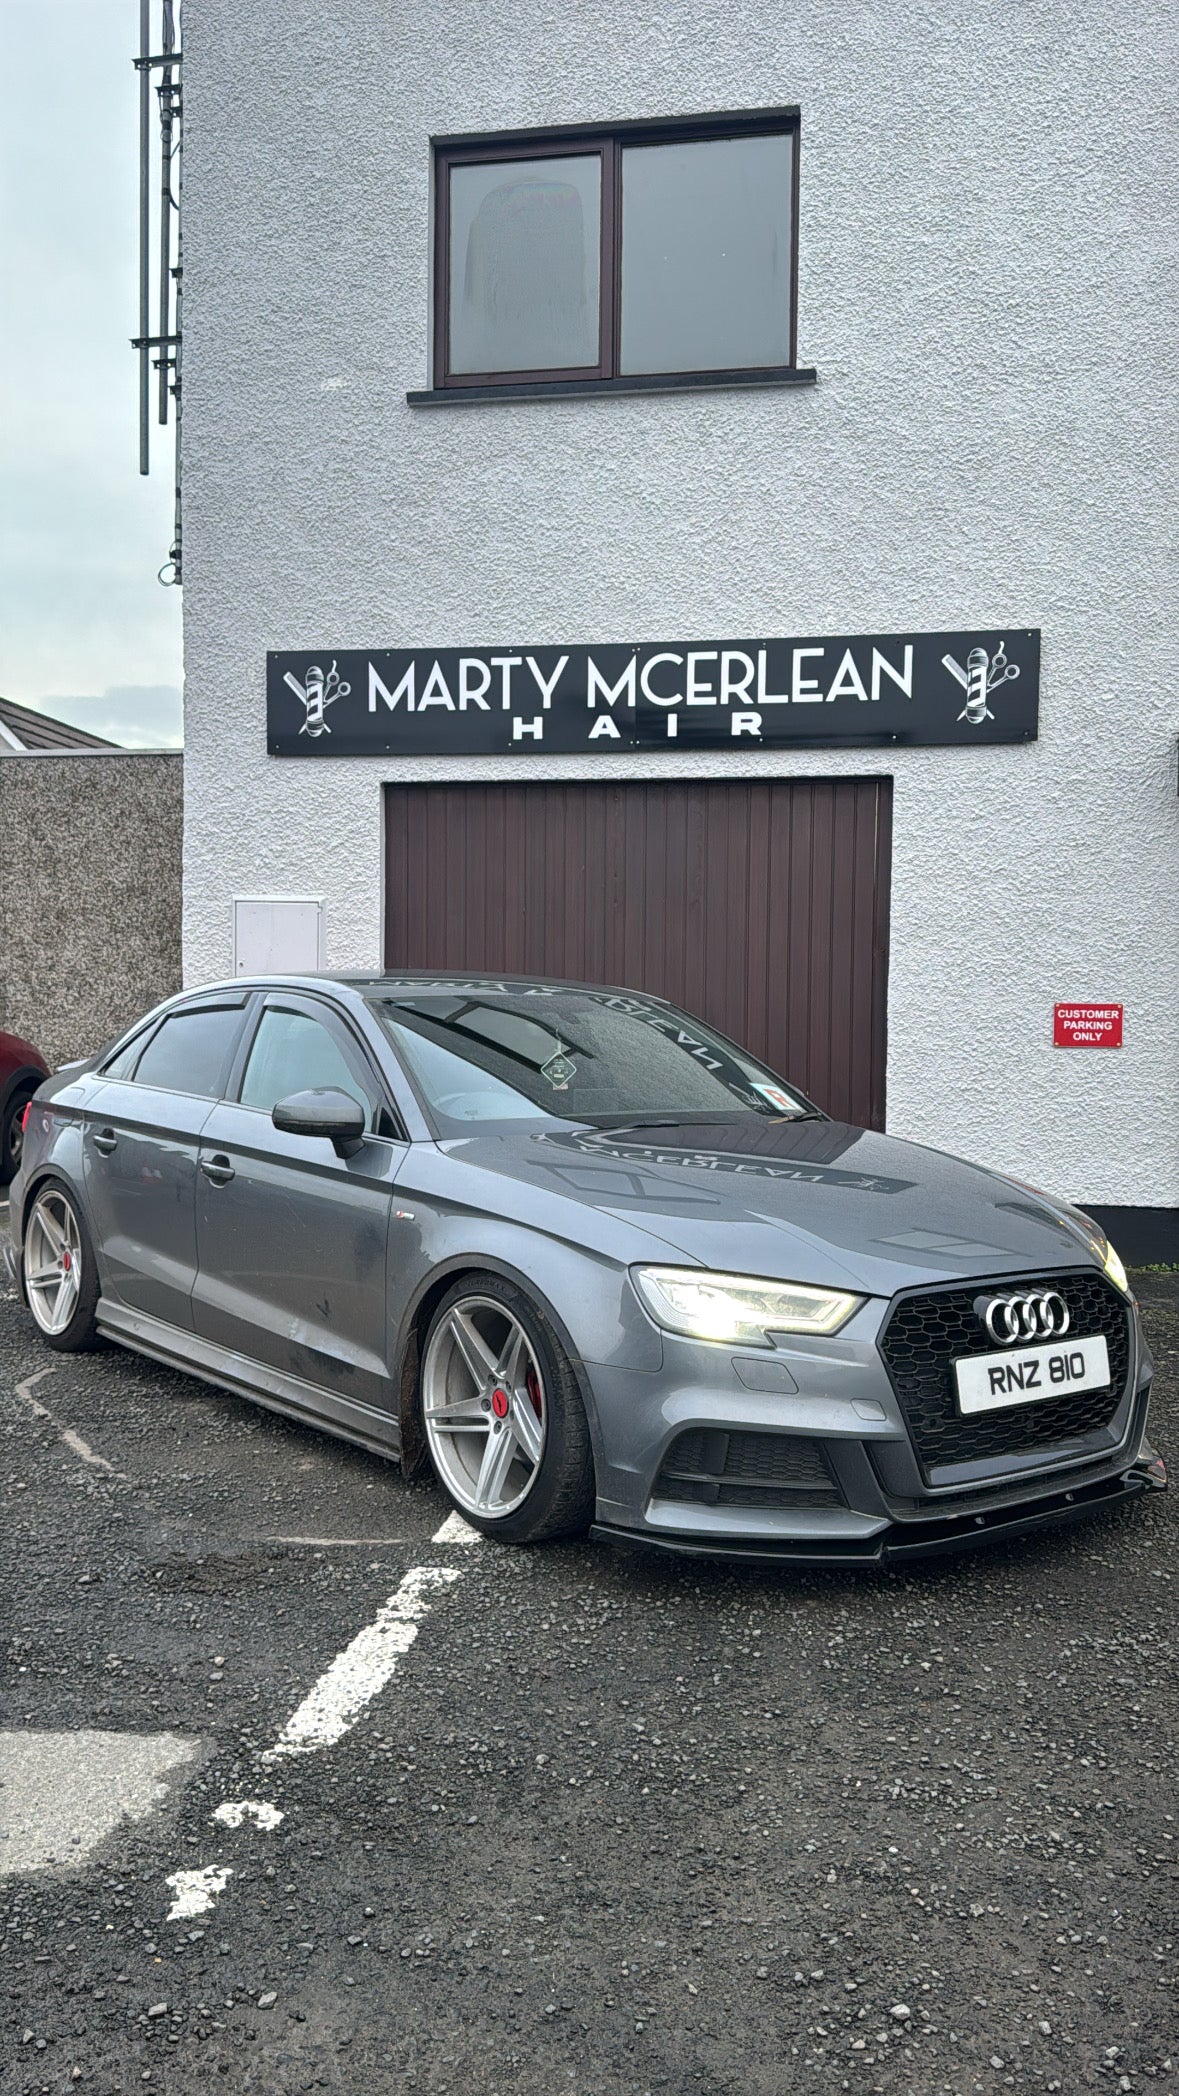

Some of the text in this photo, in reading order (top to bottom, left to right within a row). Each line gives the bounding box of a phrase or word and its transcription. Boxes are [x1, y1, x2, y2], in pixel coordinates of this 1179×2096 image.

[368, 645, 914, 713] MARTY MCERLEAN
[1057, 1009, 1120, 1020] CUSTOMER
[1063, 1020, 1113, 1031] PARKING
[1072, 1031, 1103, 1041] ONLY
[987, 1351, 1086, 1396] RNZ 810
